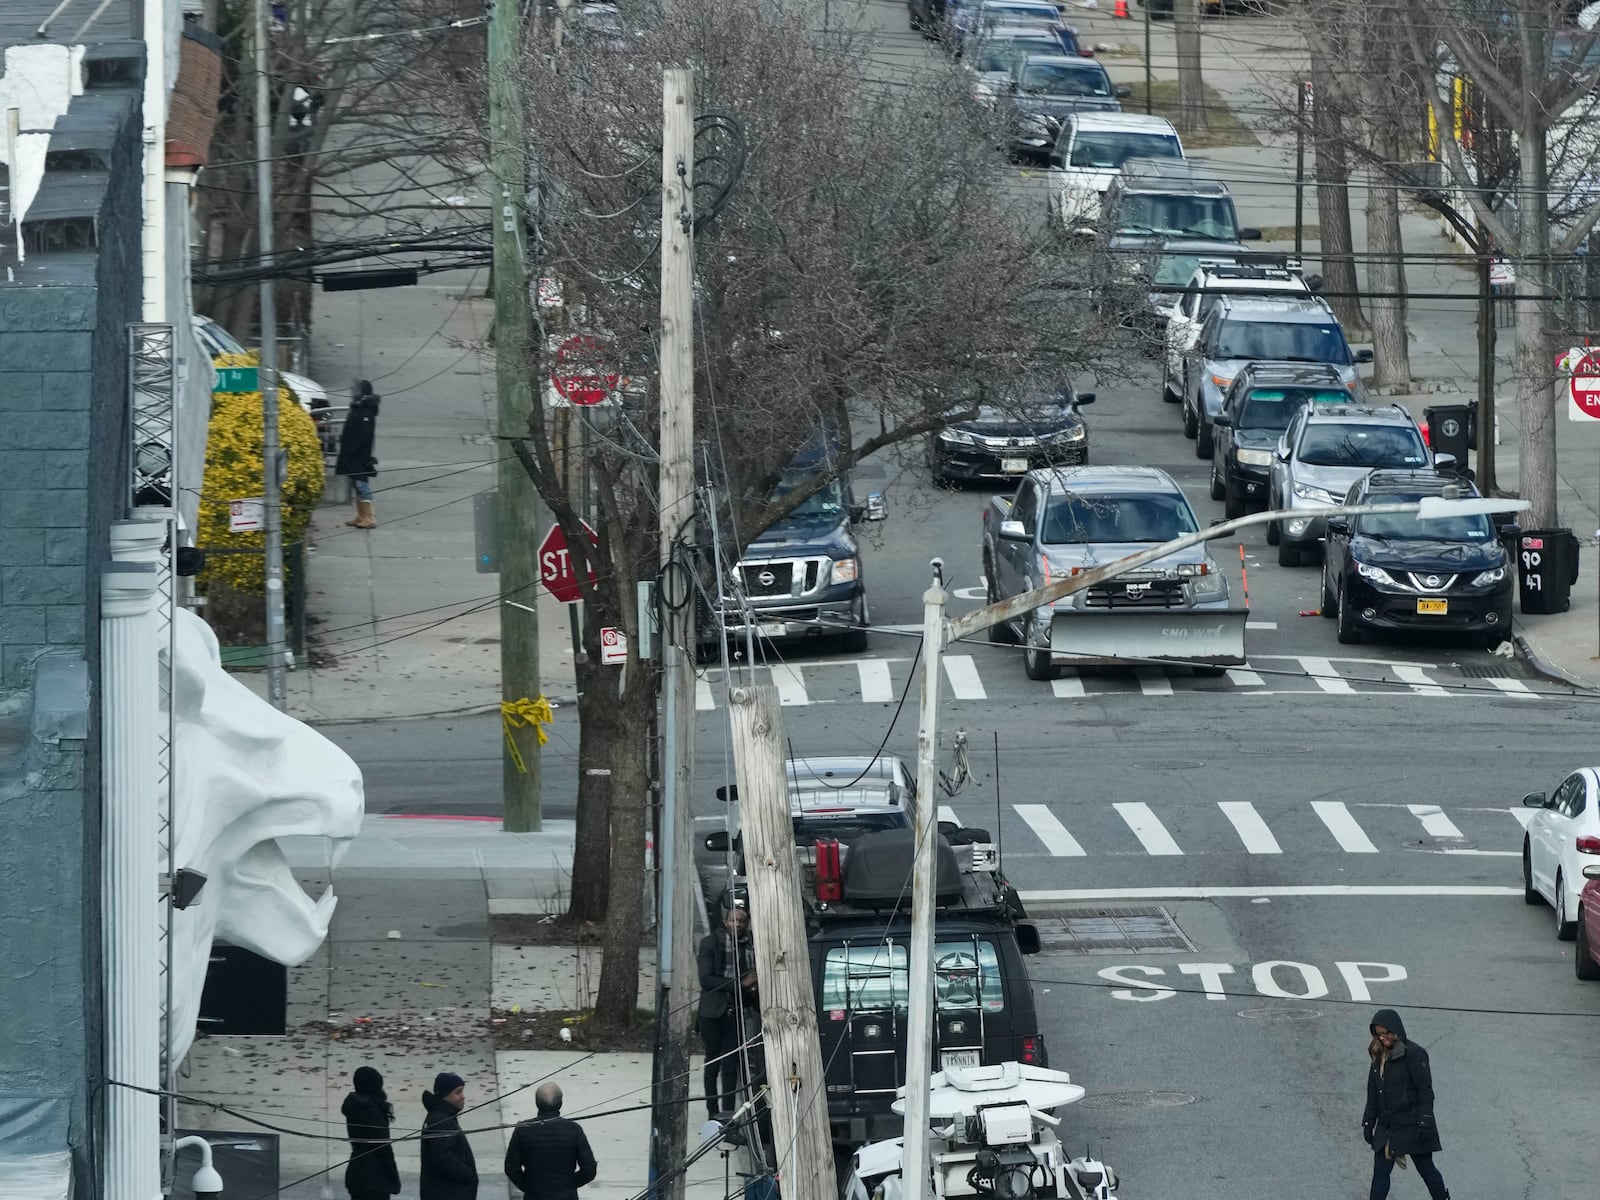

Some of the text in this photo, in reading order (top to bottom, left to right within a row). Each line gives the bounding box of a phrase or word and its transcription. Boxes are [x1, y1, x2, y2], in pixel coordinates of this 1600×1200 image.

[1522, 551, 1541, 570] 90
[1526, 573, 1541, 591] 47
[1097, 960, 1408, 1002] STOP
